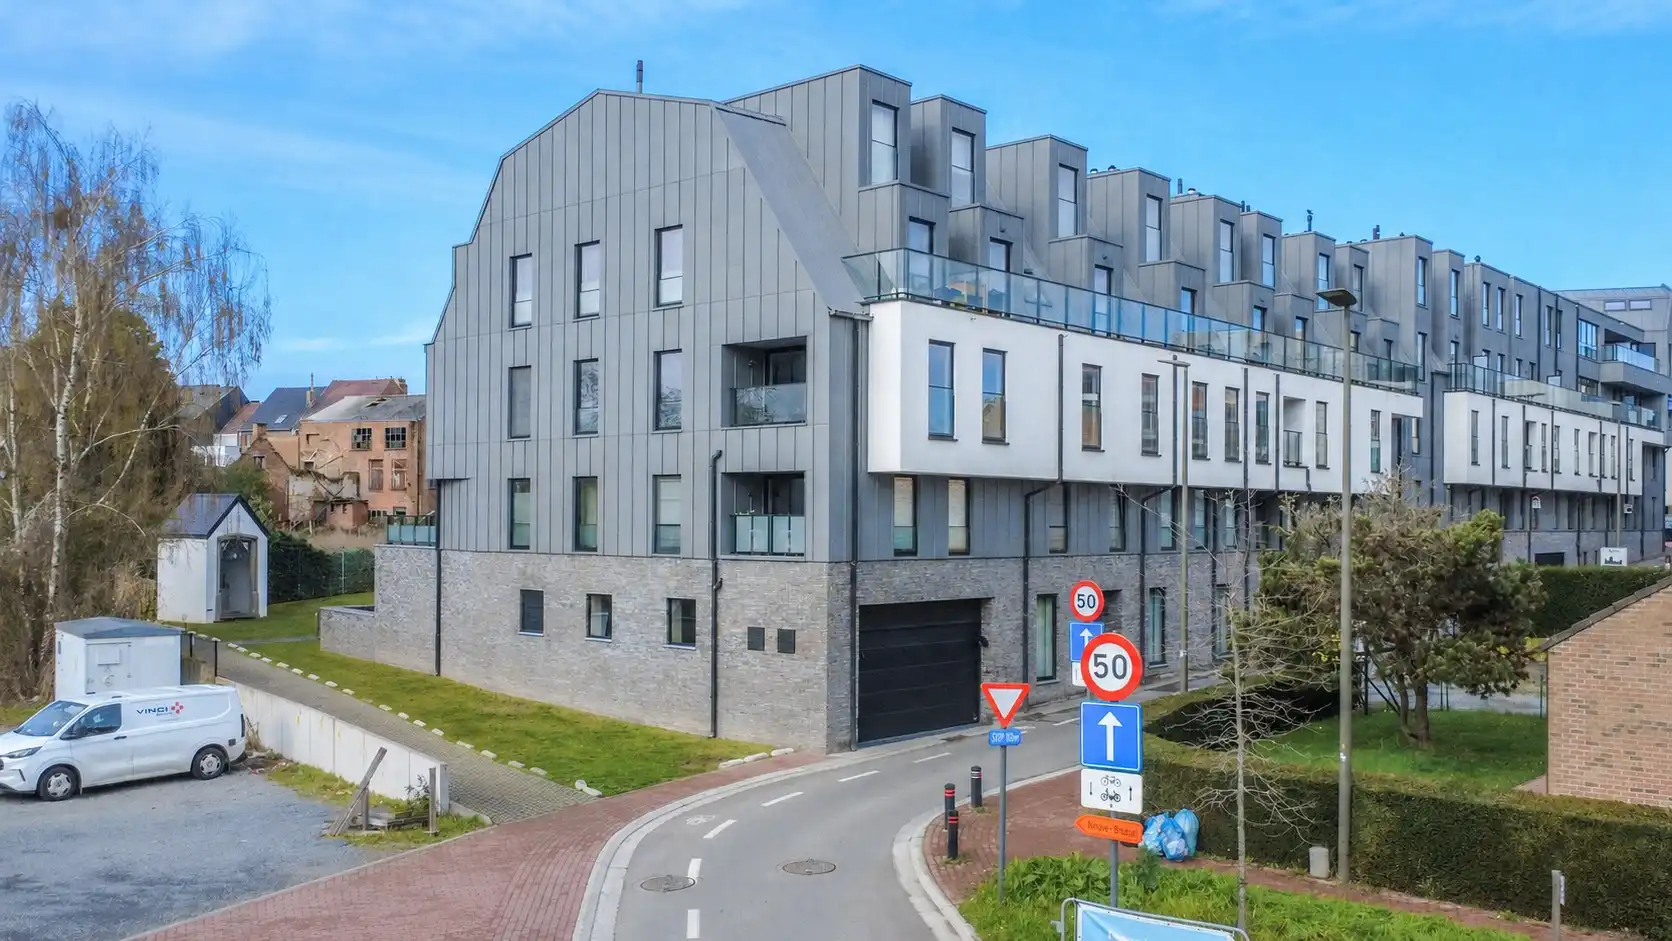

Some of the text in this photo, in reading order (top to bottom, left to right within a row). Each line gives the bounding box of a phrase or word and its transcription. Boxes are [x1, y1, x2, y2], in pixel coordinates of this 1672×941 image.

[1077, 594, 1096, 609] 50
[1093, 653, 1128, 680] 50
[136, 706, 168, 714] VINCI
